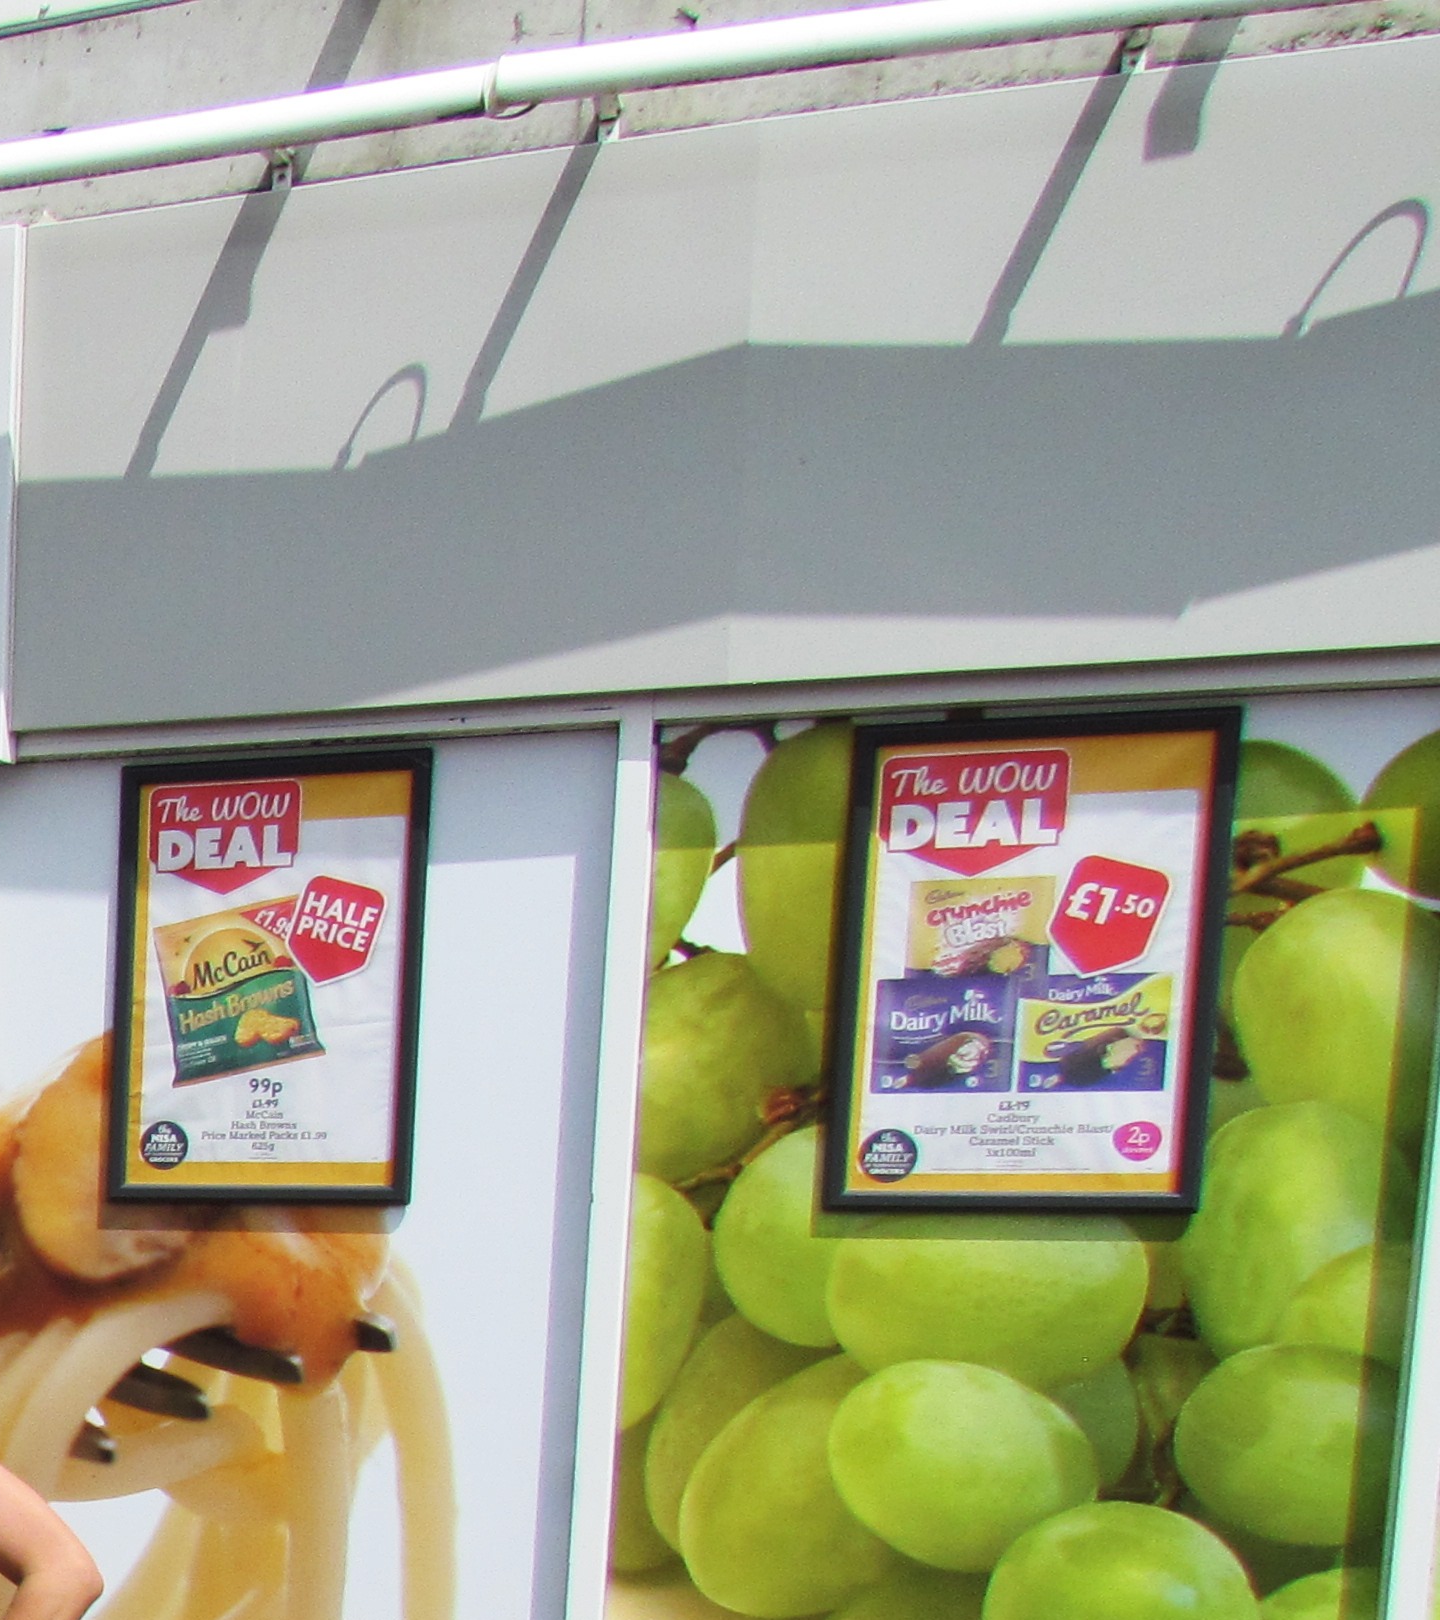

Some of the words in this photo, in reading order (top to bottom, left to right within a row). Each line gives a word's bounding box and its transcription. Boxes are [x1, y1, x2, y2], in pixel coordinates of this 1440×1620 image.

[891, 765, 948, 798] The
[958, 761, 1058, 795] WOW
[157, 795, 203, 824] The
[211, 791, 291, 821] WOW
[888, 798, 1058, 851] DEAL
[157, 824, 293, 872] DEAL
[303, 891, 379, 929] HALF
[1065, 882, 1156, 925] £1.50
[296, 914, 370, 953] PRICE
[191, 950, 272, 990] McCain
[1048, 988, 1085, 1004] Dairy
[1085, 983, 1118, 997] Milk
[179, 1000, 226, 1035] Hash
[226, 980, 296, 1017] Browns
[889, 1009, 948, 1033] Dairy
[949, 1002, 1002, 1025] Milk
[1034, 991, 1151, 1036] Caramel
[249, 1077, 283, 1097] 99p
[245, 1110, 284, 1119] McCain
[986, 1113, 1040, 1125] Cadbury
[201, 1131, 226, 1140] Price
[229, 1131, 267, 1140] Marked
[269, 1131, 298, 1140] Packs
[231, 1121, 256, 1130] Hash
[259, 1121, 297, 1130] Browns
[914, 1125, 947, 1136] Dairy
[950, 1125, 977, 1135] Milk
[1127, 1125, 1151, 1146] 2p
[144, 1143, 185, 1152] FAMILY
[150, 1134, 177, 1143] NISA
[969, 1137, 1020, 1146] Caramel
[1022, 1136, 1055, 1146] Stick
[864, 1152, 912, 1163] FAMILY
